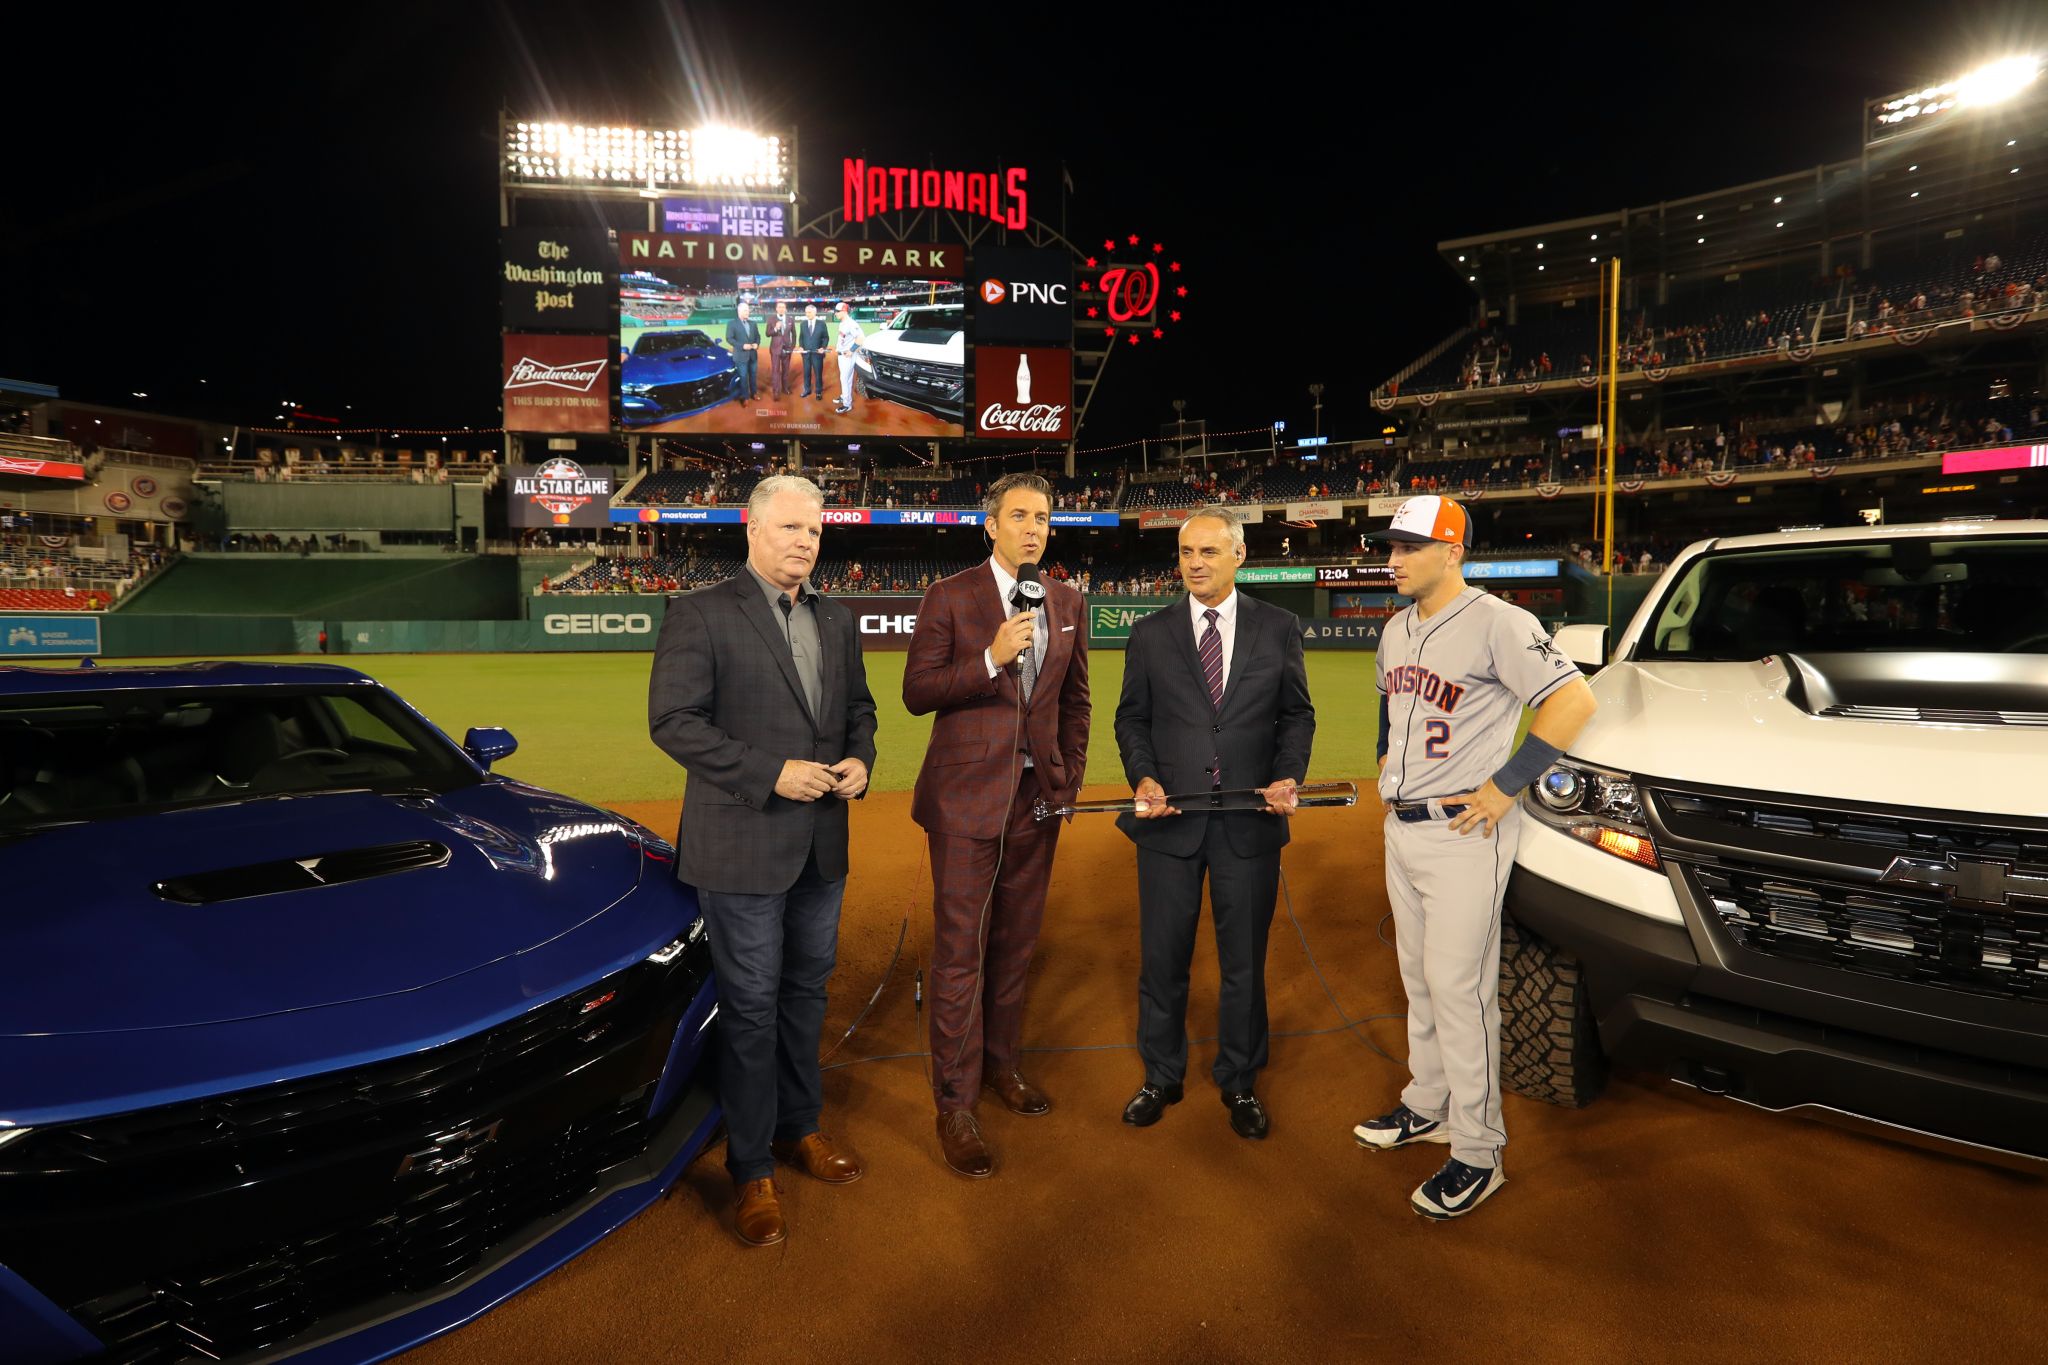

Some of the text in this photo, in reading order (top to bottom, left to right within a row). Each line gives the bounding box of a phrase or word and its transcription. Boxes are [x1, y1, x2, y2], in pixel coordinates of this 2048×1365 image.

[843, 158, 1027, 230] NATIONALS
[722, 206, 748, 218] HIT
[752, 207, 767, 219] IT
[722, 219, 784, 237] HERE
[538, 240, 569, 261] The
[632, 239, 945, 268] NATIONALS PARK
[504, 261, 604, 288] Washington
[535, 290, 574, 312] Post
[1010, 282, 1067, 305] PNC
[513, 365, 596, 381] Budweiser
[513, 396, 533, 406] THIS
[535, 397, 561, 407] BUD'S
[562, 397, 579, 407] FOR
[980, 403, 1066, 433] Coca-Cola
[514, 479, 608, 495] ALL STAR GAME
[820, 511, 862, 523] TFORD
[1246, 571, 1313, 581] Harris Teeter
[1319, 568, 1349, 580] 12:04
[1024, 583, 1040, 593] FOX
[544, 613, 652, 635] GEICO
[860, 615, 918, 634] CHE
[1322, 626, 1378, 638] DELTA
[1385, 665, 1465, 715] OUSTON
[1425, 719, 1450, 760] 2
